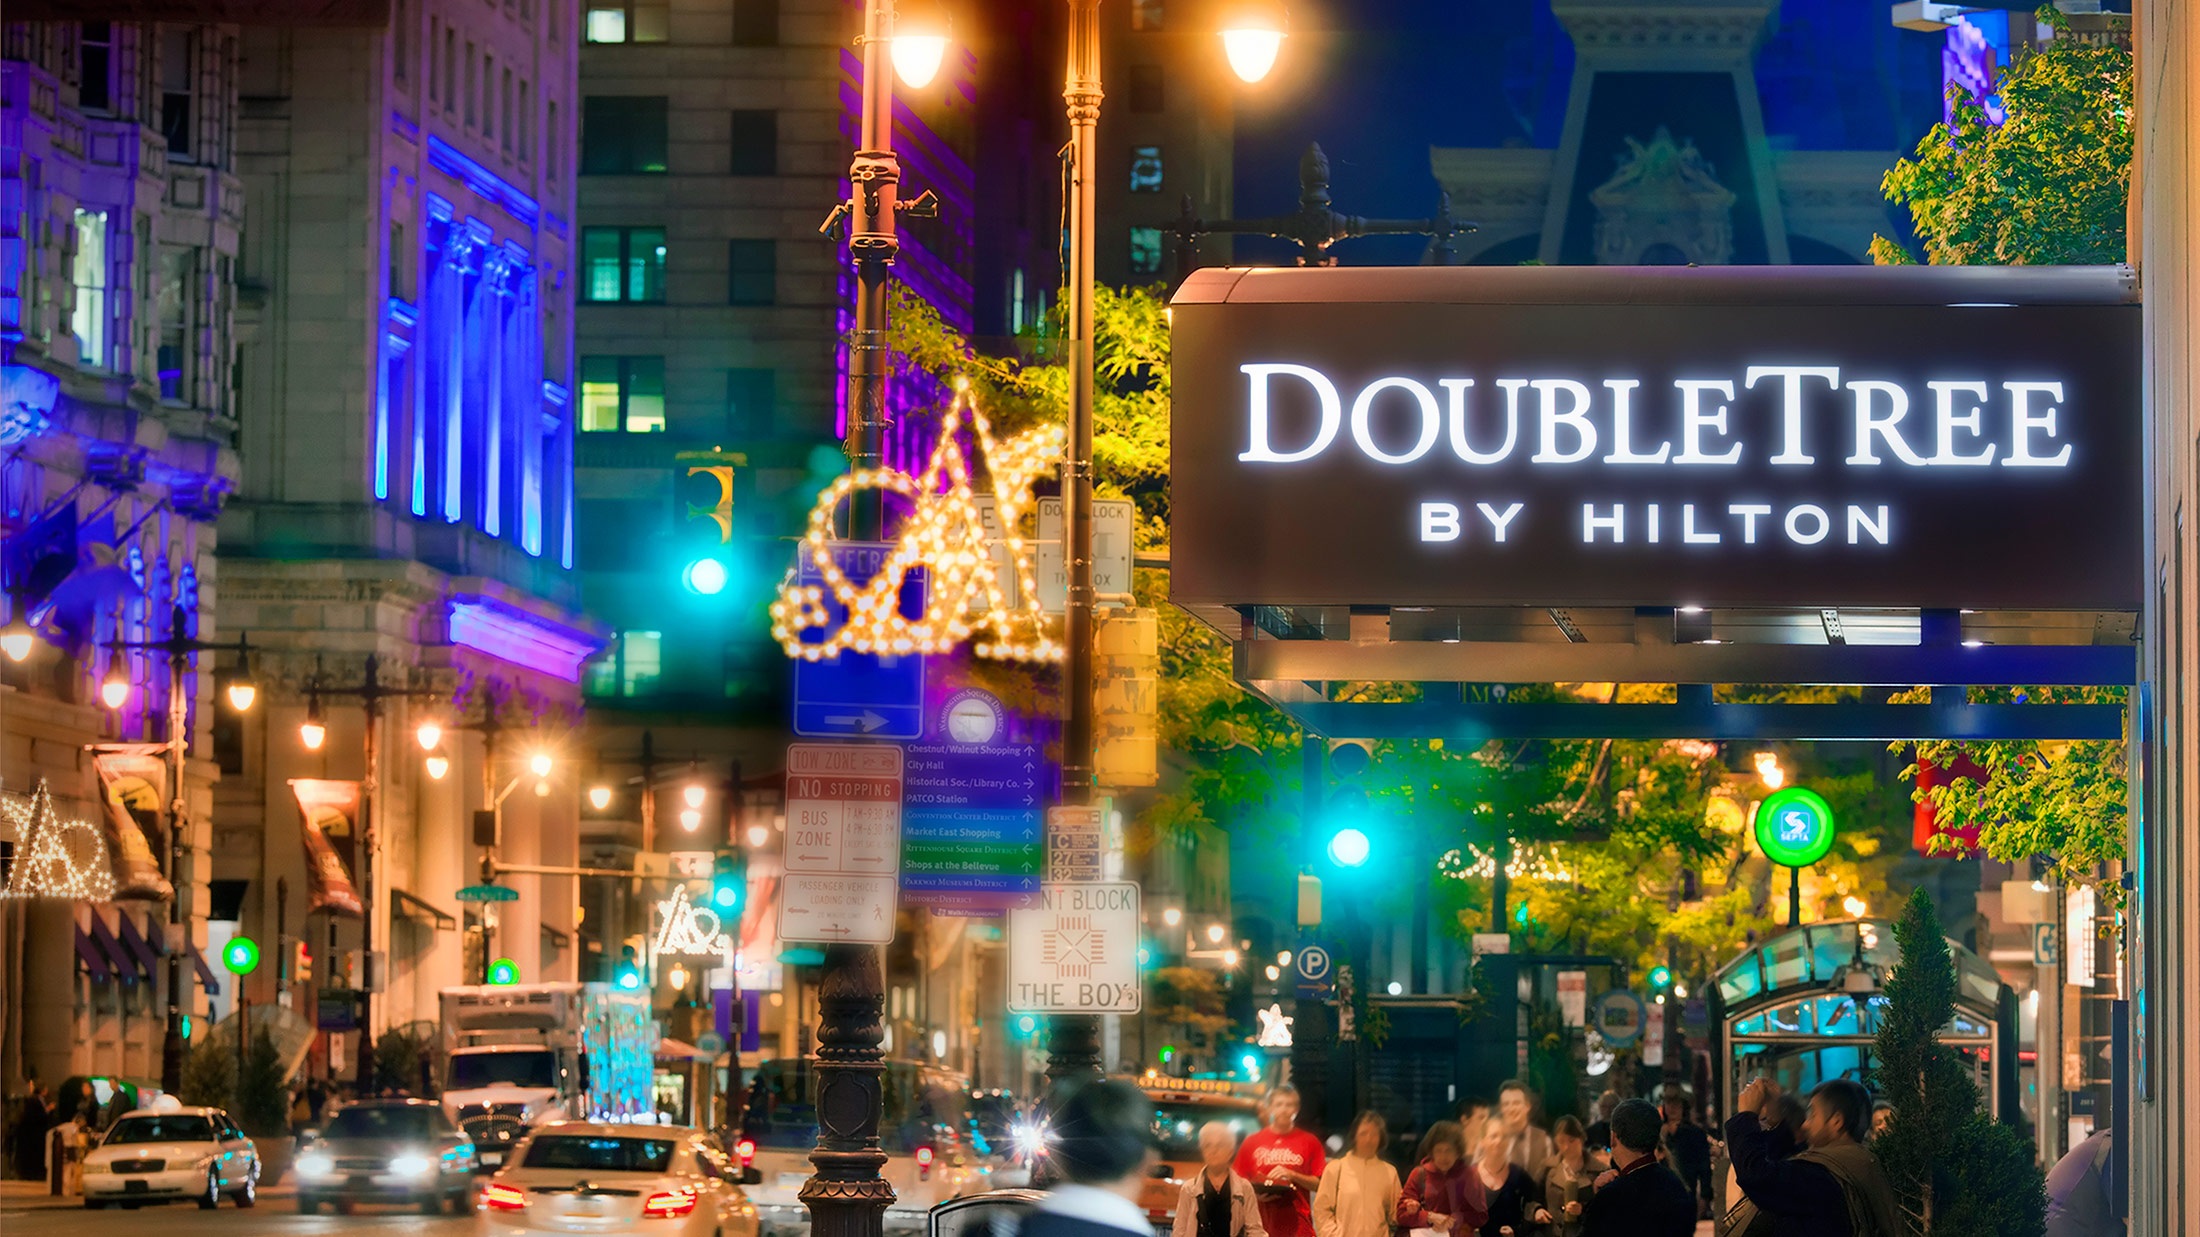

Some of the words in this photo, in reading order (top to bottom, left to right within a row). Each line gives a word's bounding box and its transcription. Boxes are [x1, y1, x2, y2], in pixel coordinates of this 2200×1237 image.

[1092, 505, 1124, 518] LOCK
[1420, 502, 1524, 545] BY
[1582, 503, 1890, 546] HILTON
[807, 549, 919, 576] EFFER
[938, 690, 966, 733] WASHINGTON
[966, 688, 994, 704] SQUARE
[991, 698, 1005, 734] DISTRICT
[907, 743, 979, 755] Chestnut/Walnut
[980, 745, 1021, 757] Shopping
[795, 751, 819, 770] TOW
[825, 751, 857, 770] ZONE
[907, 760, 925, 771] City
[926, 760, 944, 770] Hall
[799, 779, 821, 798] NO
[830, 782, 891, 797] STOPPING
[906, 776, 948, 787] Historical
[950, 777, 1004, 789] Soc./Library
[1006, 778, 1020, 789] Co.
[906, 793, 935, 804] PATCO
[936, 794, 968, 804] Station
[801, 810, 828, 826] BUS
[906, 810, 952, 820] CONVENTION
[953, 812, 982, 821] CENTER
[983, 812, 1016, 822] DISTRICT
[796, 831, 832, 847] ZONE
[905, 826, 937, 837] Market
[938, 828, 957, 837] East
[959, 828, 1001, 839] Shopping
[1780, 832, 1809, 842] SEPTA
[1057, 834, 1069, 849] C
[905, 844, 954, 853] RITTENHOUSE
[955, 845, 982, 854] SQUARE
[984, 845, 1018, 855] DISTRICT
[904, 860, 932, 871] Shops
[934, 861, 943, 870] at
[945, 861, 960, 870] the
[961, 861, 1000, 871] Bellevue
[1053, 851, 1073, 866] 27
[1053, 868, 1073, 882] 32
[799, 880, 844, 892] PASSENGER
[847, 882, 880, 893] VEHICLE
[904, 878, 938, 886] PARKWAY
[938, 878, 973, 887] MUSEUMS
[974, 879, 1008, 888] DISTRICT
[810, 895, 844, 905] LOADING
[846, 896, 866, 906] ONLY
[904, 894, 939, 904] HISTORIC
[939, 895, 972, 904] DISTRICT
[1073, 889, 1131, 911] BLOCK
[1307, 952, 1323, 974] P
[1018, 983, 1064, 1006] THE
